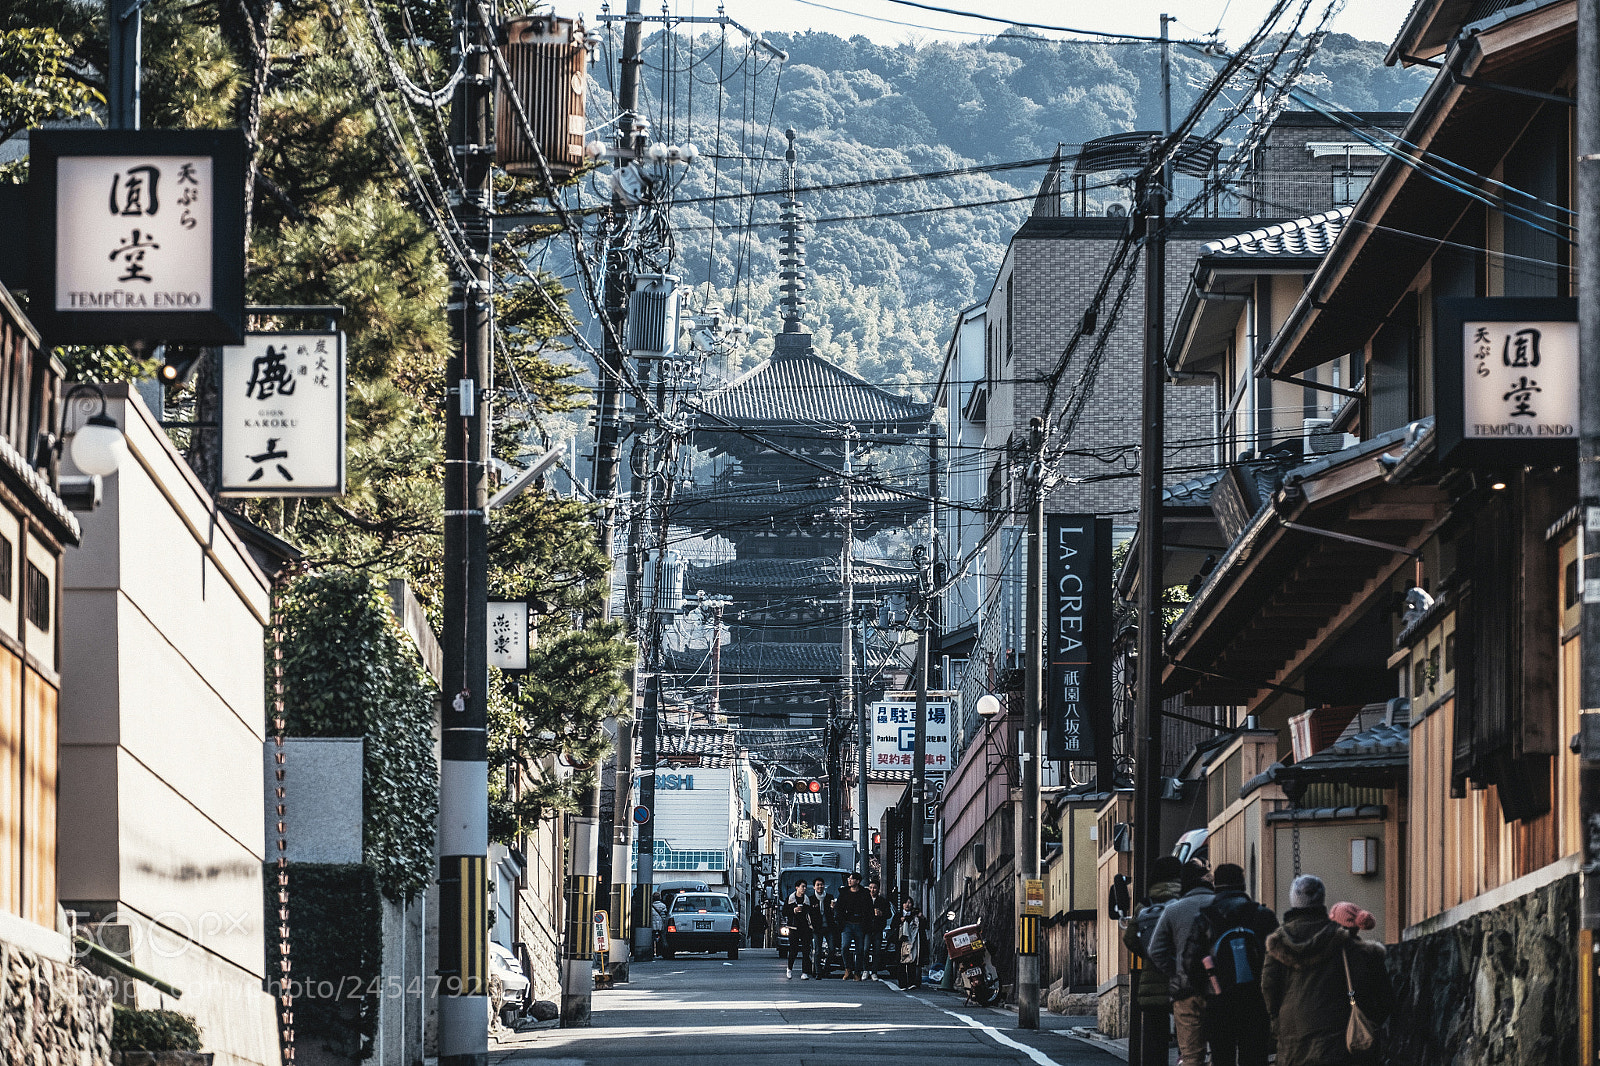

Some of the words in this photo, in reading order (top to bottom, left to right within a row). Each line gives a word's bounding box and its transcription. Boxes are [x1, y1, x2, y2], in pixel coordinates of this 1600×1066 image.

[176, 163, 199, 230] 天ぷら
[153, 291, 201, 307] ENDO
[1473, 326, 1491, 378] 天ぷら
[244, 419, 298, 428] KAROKU
[1537, 424, 1574, 436] ENDO
[1063, 670, 1080, 751] 祇園八坂通
[876, 735, 898, 743] Parking
[877, 753, 946, 765] 契約者集中
